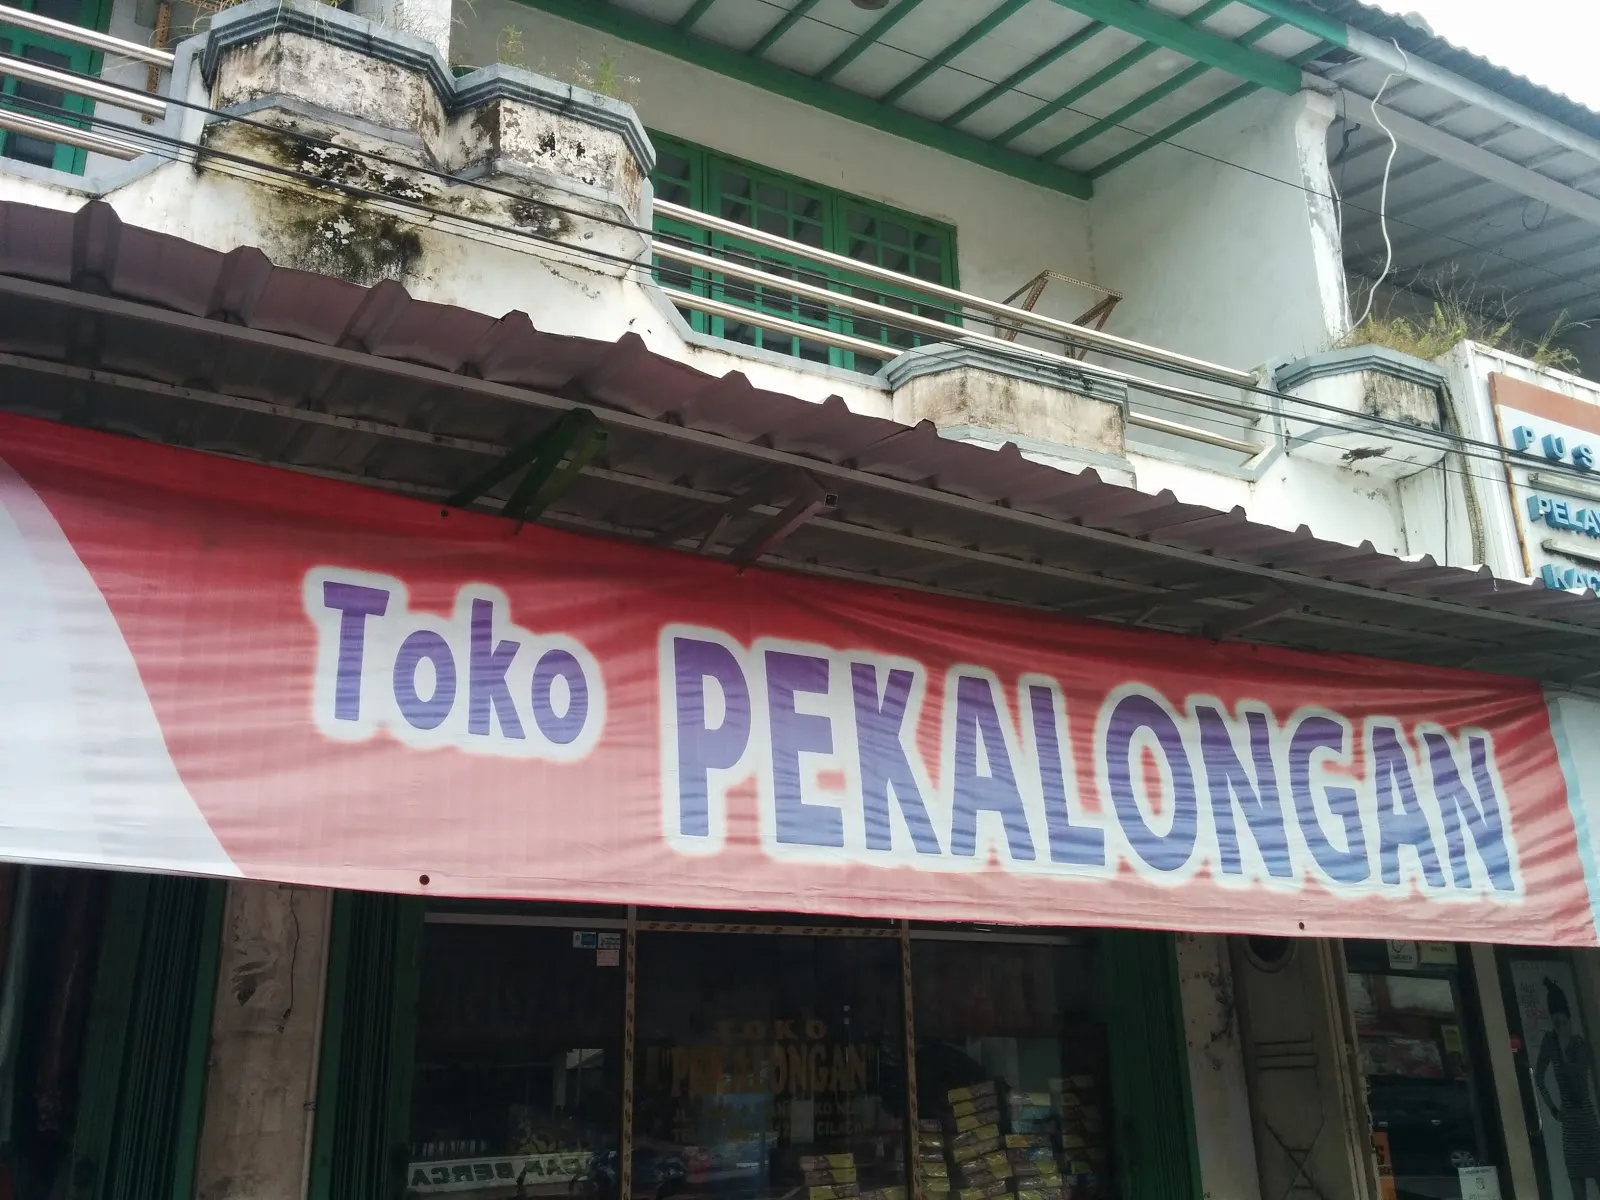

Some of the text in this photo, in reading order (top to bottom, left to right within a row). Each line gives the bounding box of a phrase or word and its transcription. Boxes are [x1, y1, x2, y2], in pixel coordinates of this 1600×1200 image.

[1527, 494, 1600, 541] PELA
[323, 580, 1516, 892] Toko PEKALONGAN
